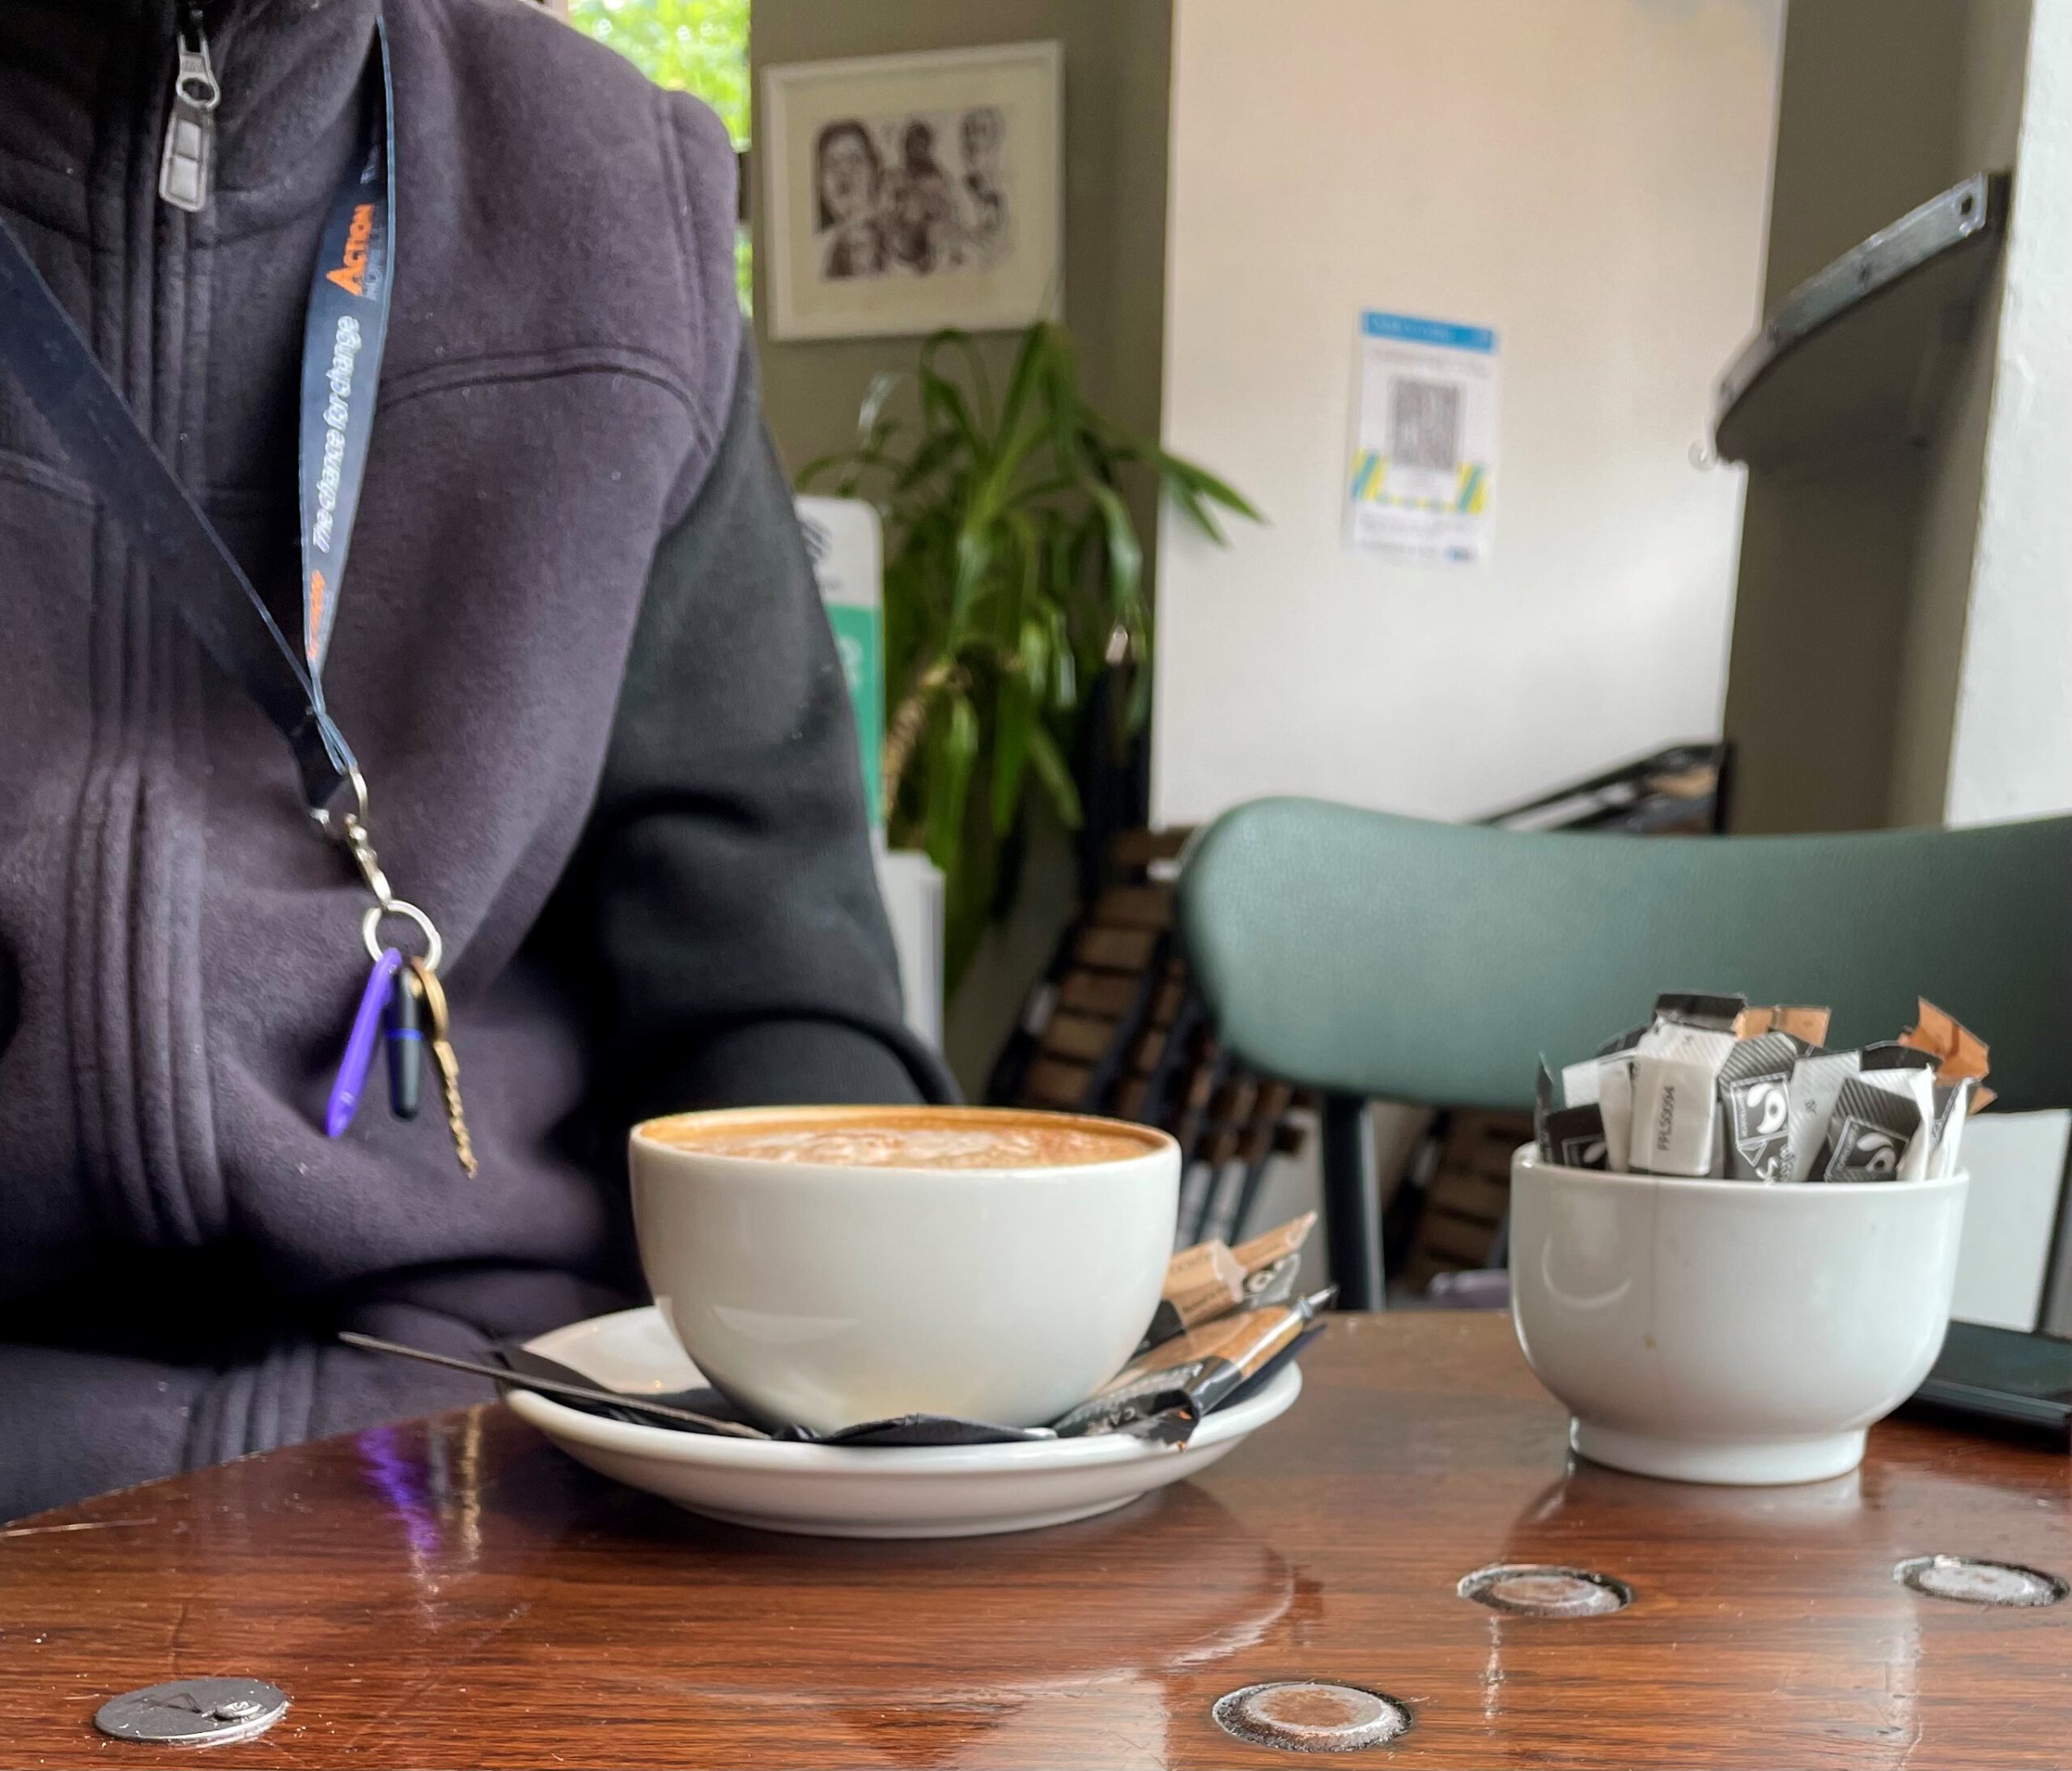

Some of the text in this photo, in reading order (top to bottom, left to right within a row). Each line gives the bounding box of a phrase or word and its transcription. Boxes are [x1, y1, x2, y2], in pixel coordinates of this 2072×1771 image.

[325, 315, 362, 397] change
[323, 392, 348, 431] for
[316, 428, 345, 511] chance
